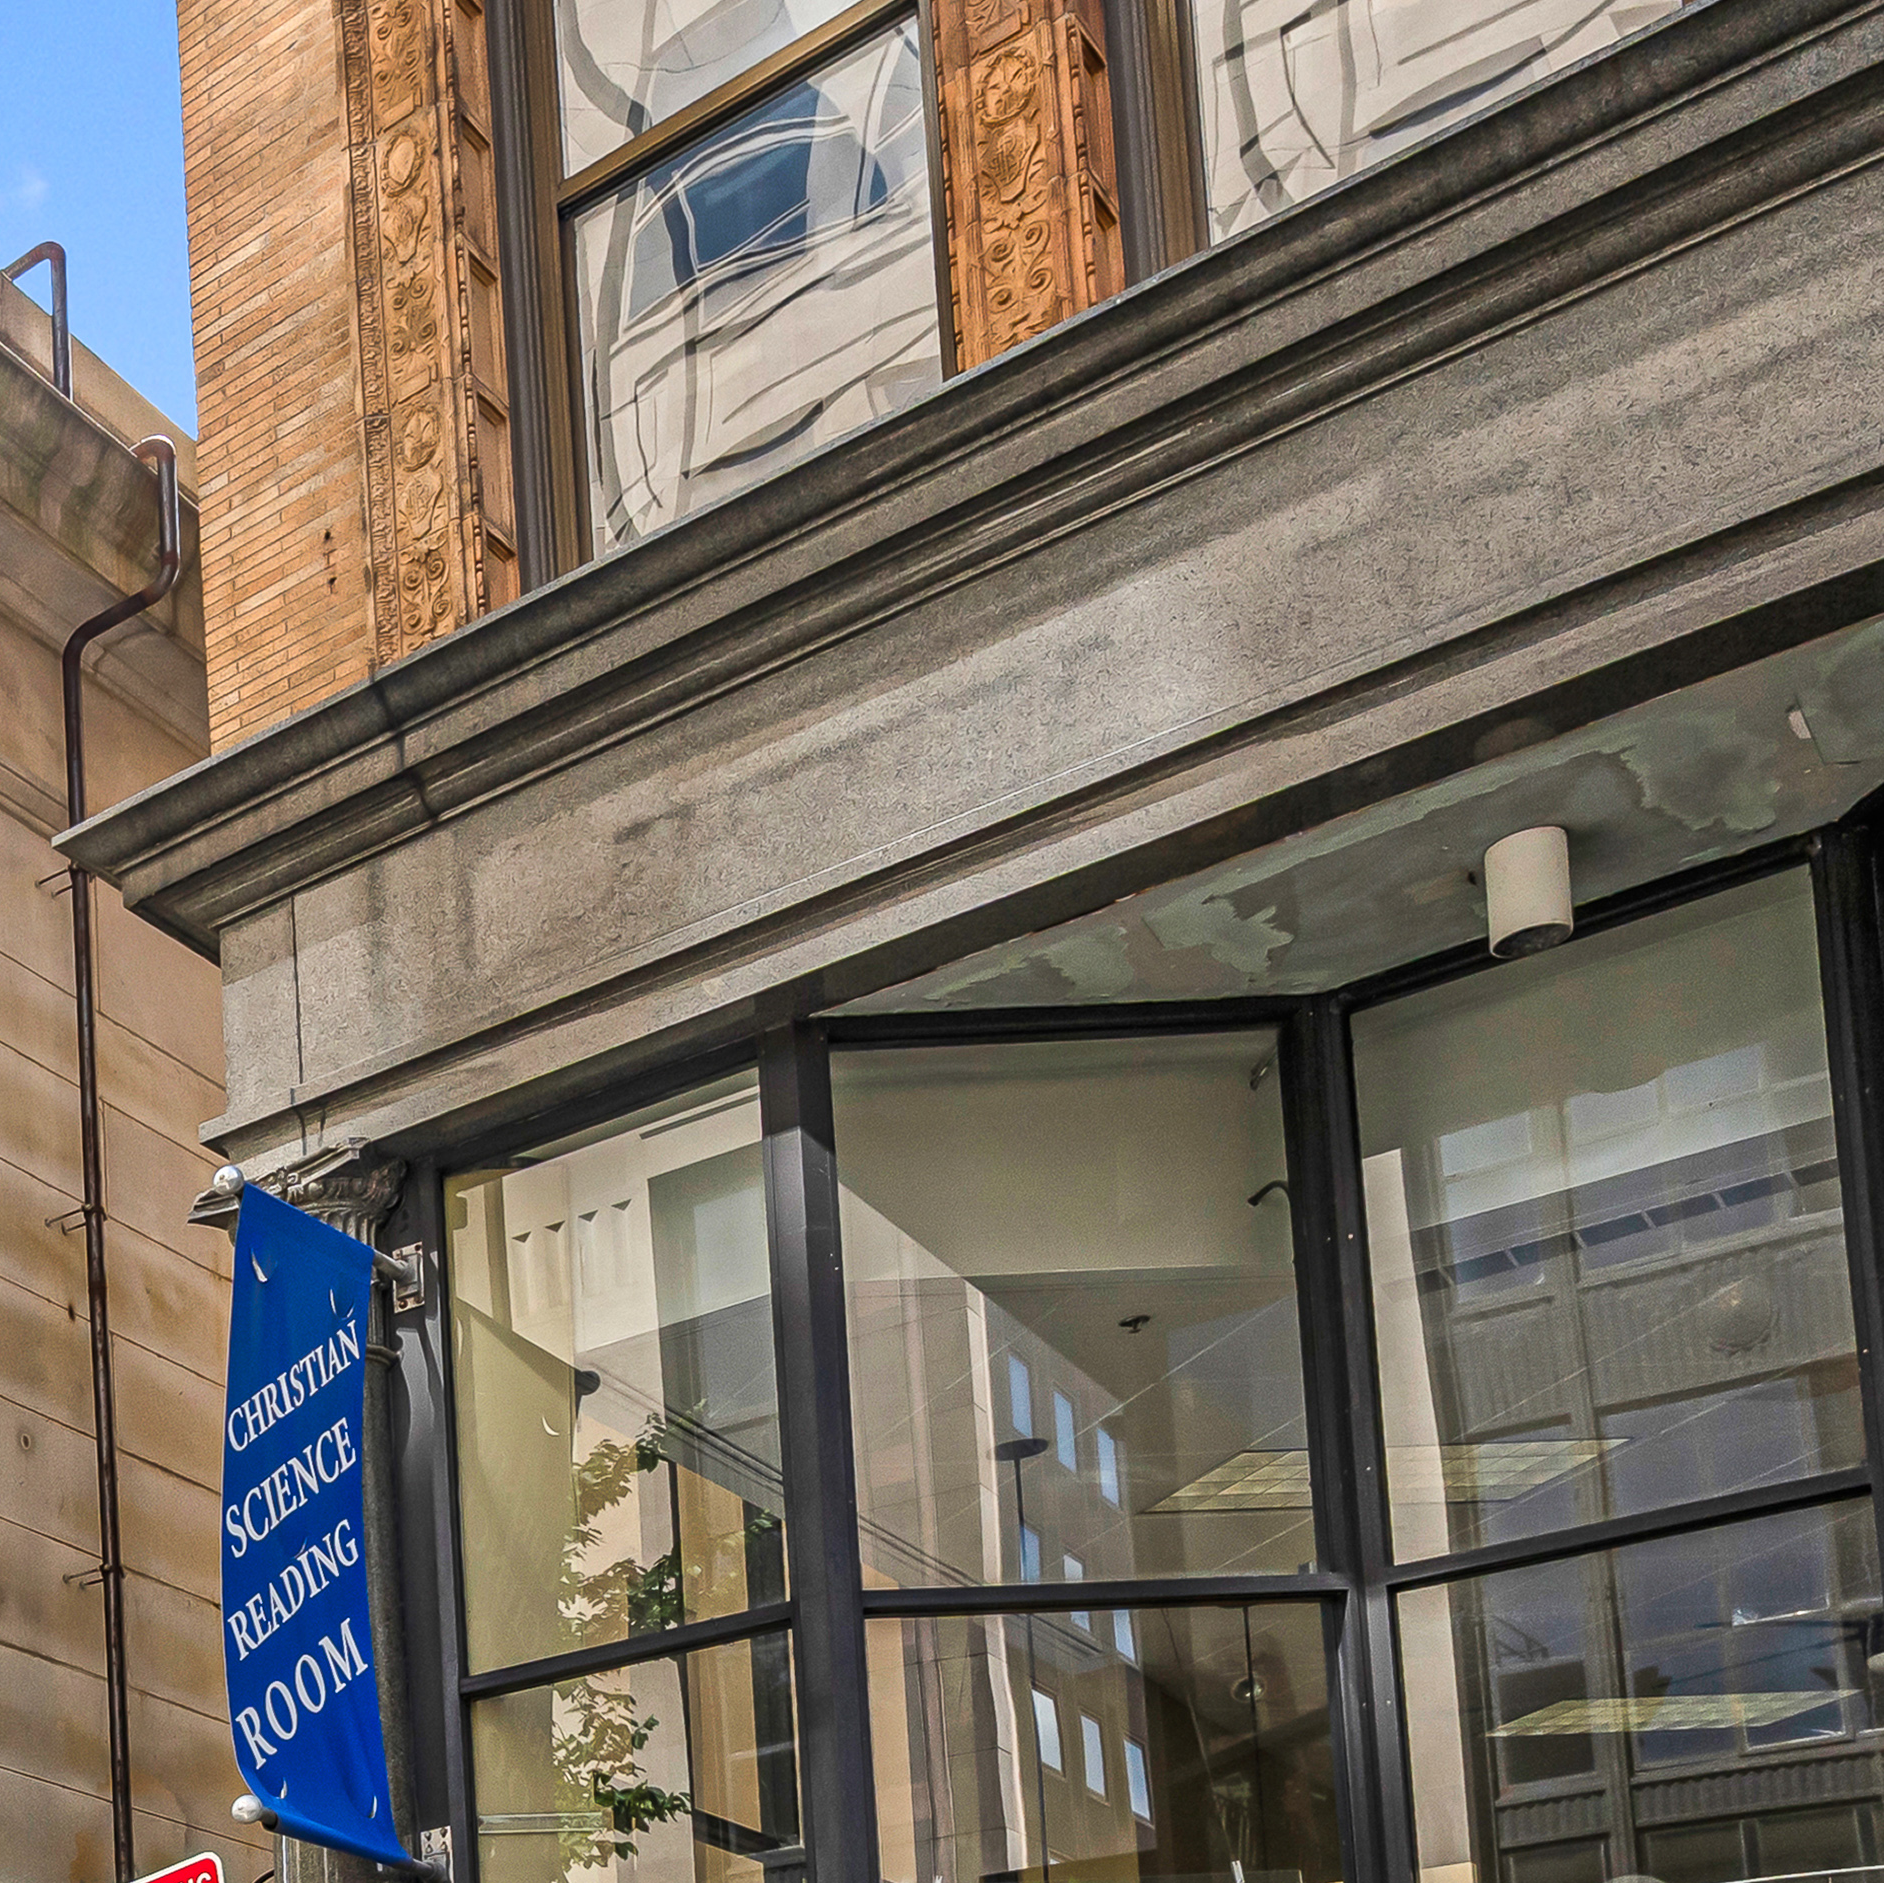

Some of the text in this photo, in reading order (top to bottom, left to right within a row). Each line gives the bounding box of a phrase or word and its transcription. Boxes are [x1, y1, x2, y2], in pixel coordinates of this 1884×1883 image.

[228, 1319, 362, 1453] CHRISTIAN
[226, 1417, 357, 1559] SCIENCE
[228, 1519, 359, 1661] READING
[235, 1618, 369, 1769] ROOM
